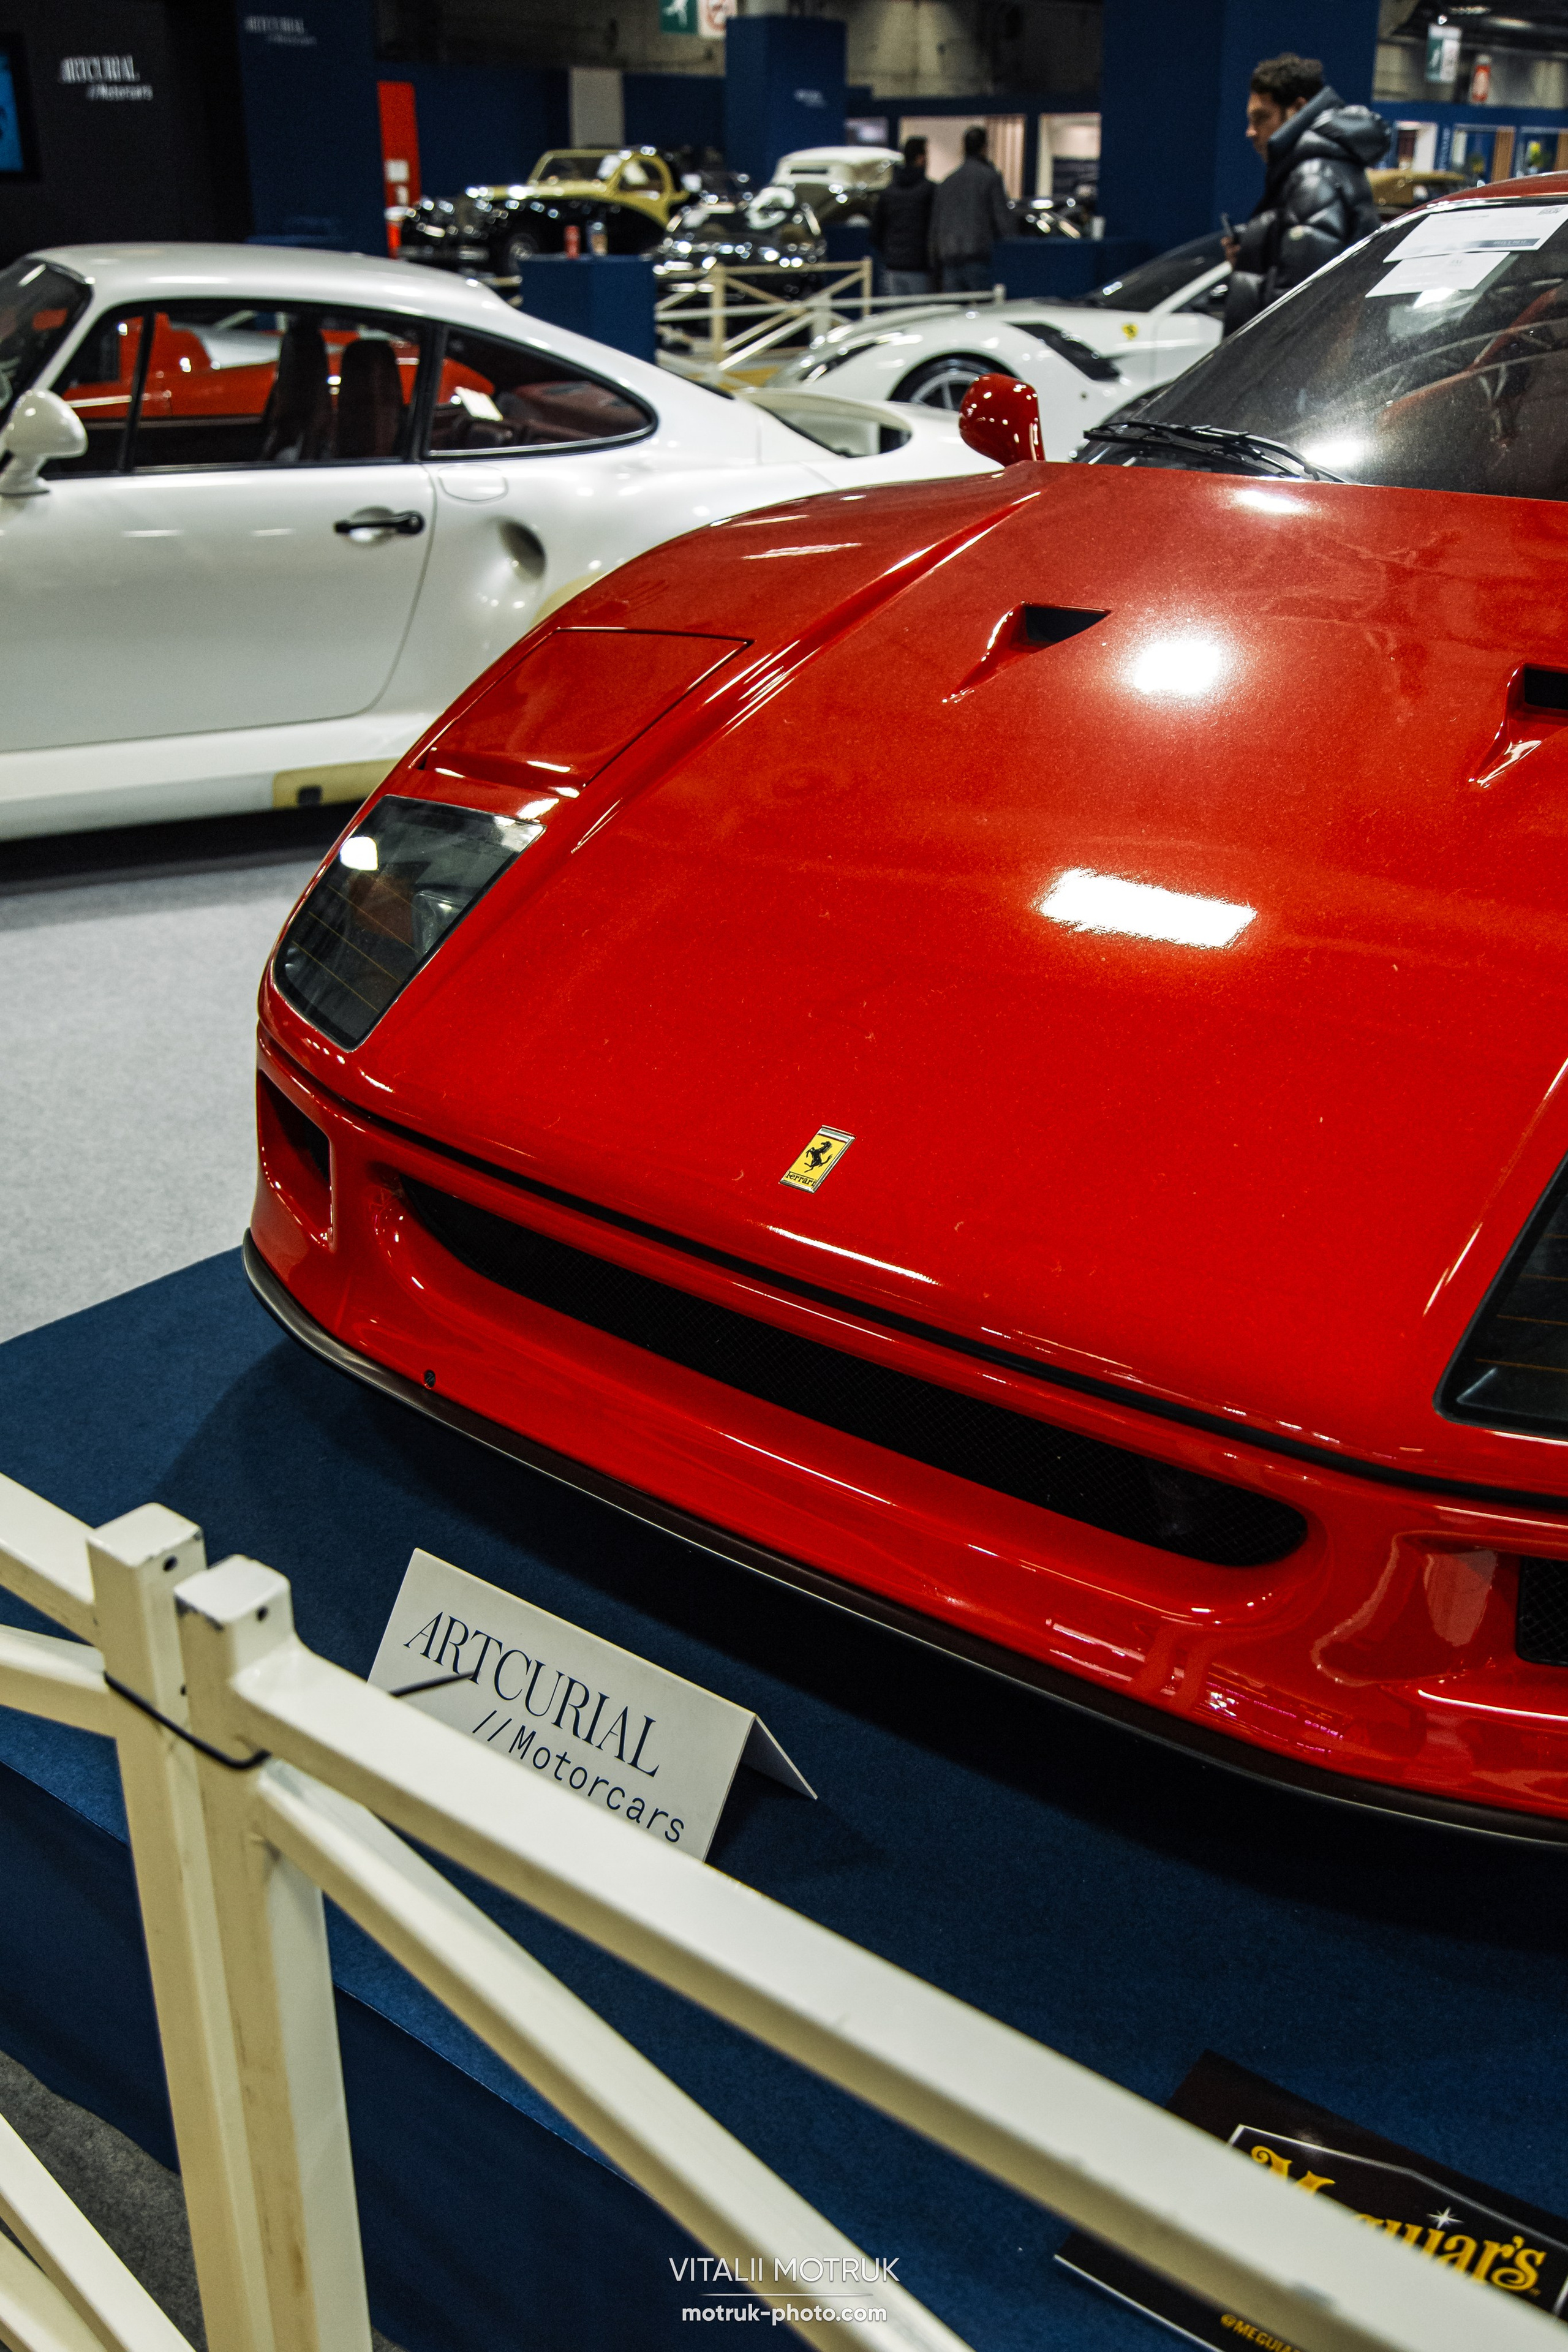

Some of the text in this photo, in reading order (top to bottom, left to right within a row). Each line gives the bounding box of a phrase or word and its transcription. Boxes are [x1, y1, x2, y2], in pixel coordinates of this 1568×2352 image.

[785, 1170, 818, 1189] Ferrari
[403, 1611, 660, 1777] ARTCURIAL
[472, 1709, 685, 1843] //Motorcars
